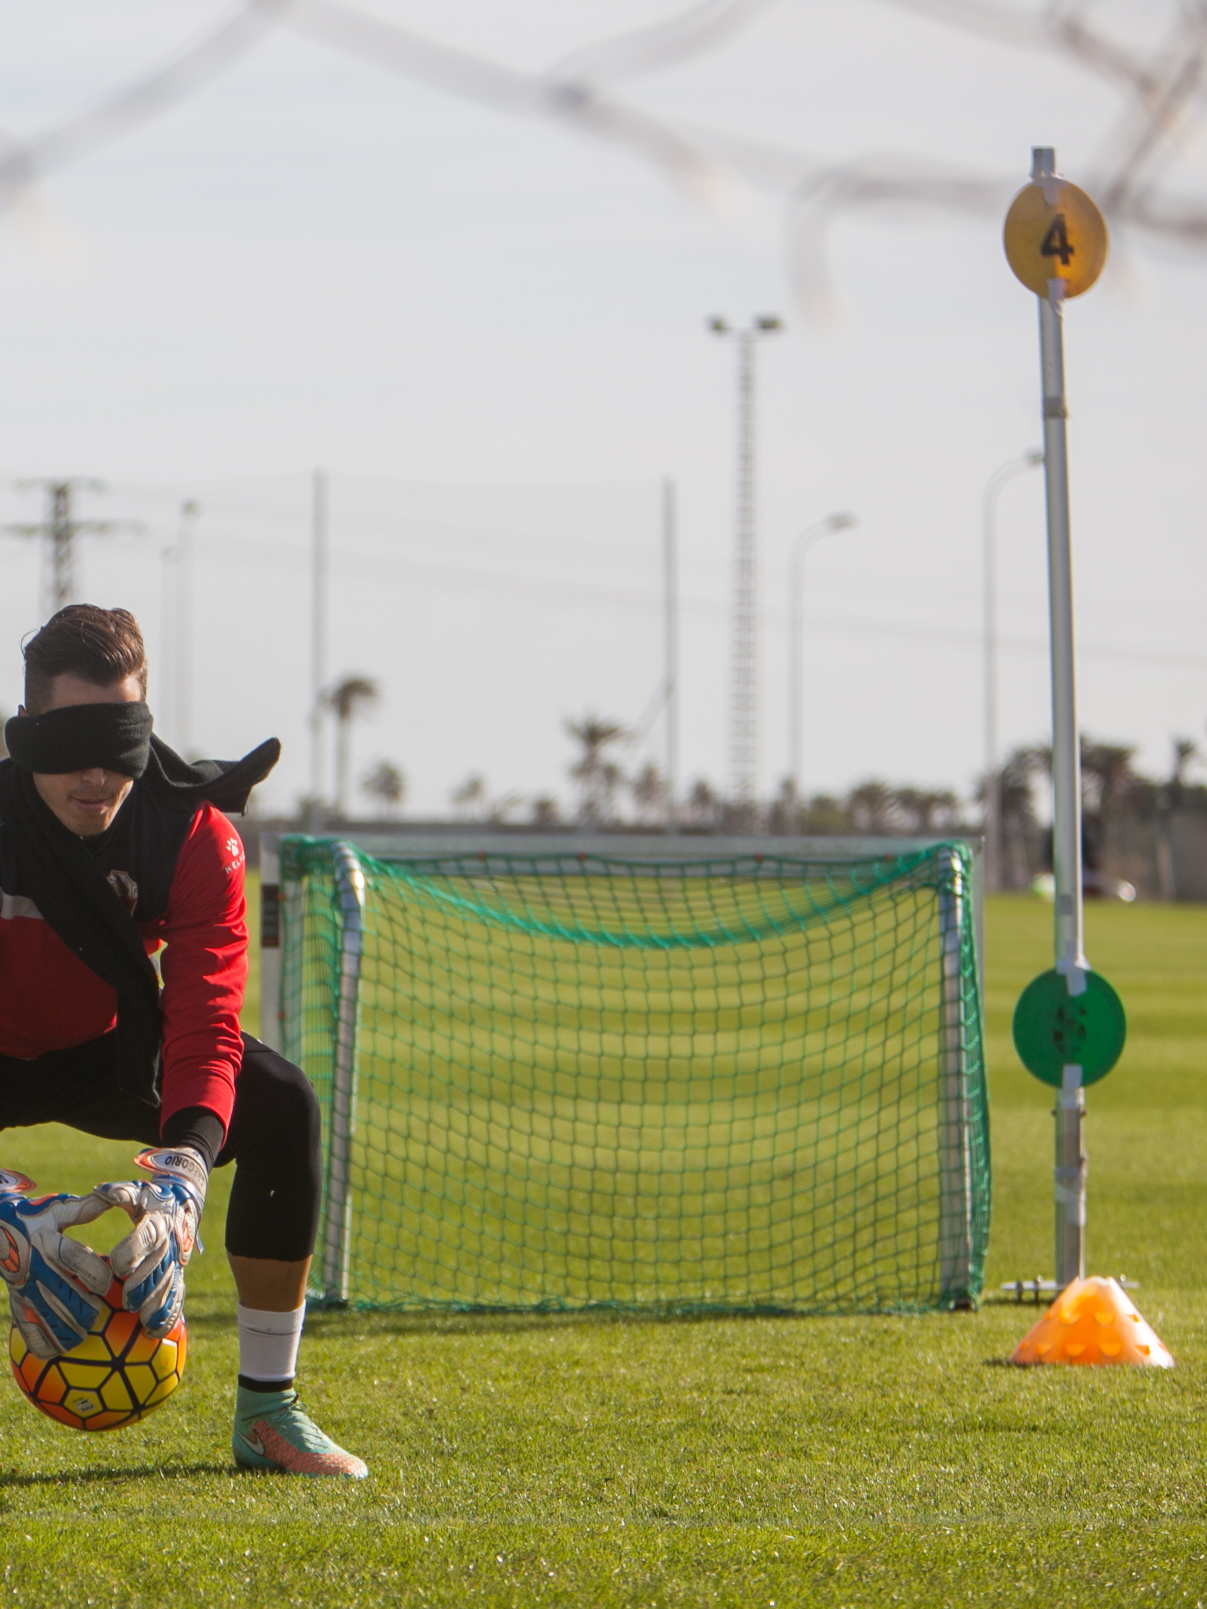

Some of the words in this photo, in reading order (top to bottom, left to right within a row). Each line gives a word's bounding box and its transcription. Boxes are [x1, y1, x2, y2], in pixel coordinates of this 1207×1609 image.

[1040, 213, 1074, 266] 4
[165, 1155, 205, 1187] GREGORIO
[73, 1262, 98, 1282] SOCCER
